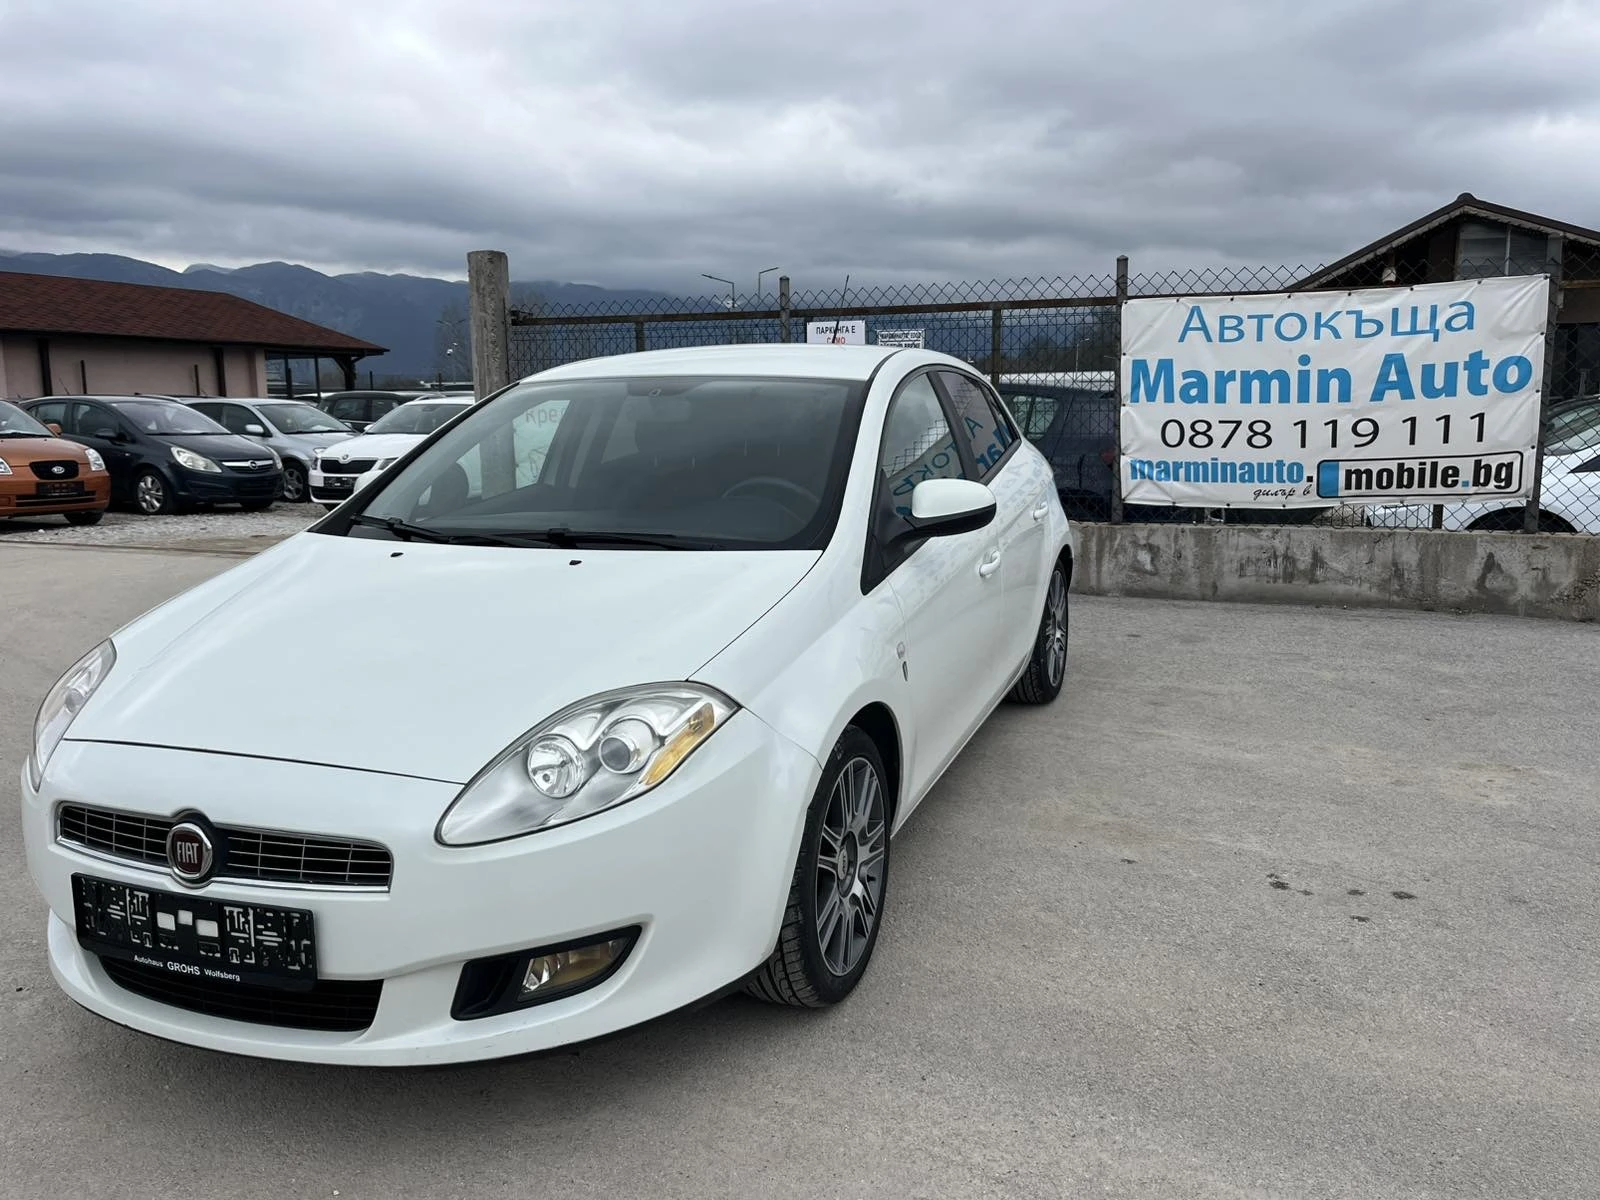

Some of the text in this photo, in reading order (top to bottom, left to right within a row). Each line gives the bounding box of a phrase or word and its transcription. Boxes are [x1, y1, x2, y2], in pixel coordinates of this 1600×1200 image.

[1178, 300, 1477, 345] Автокъща
[1129, 350, 1534, 406] Marmin Auto
[1160, 412, 1485, 449] 0878 119 111
[1344, 459, 1514, 491] mobile.bg
[176, 841, 199, 864] FIAT
[133, 954, 241, 982] Autohaus GROHS Wolfsberg
